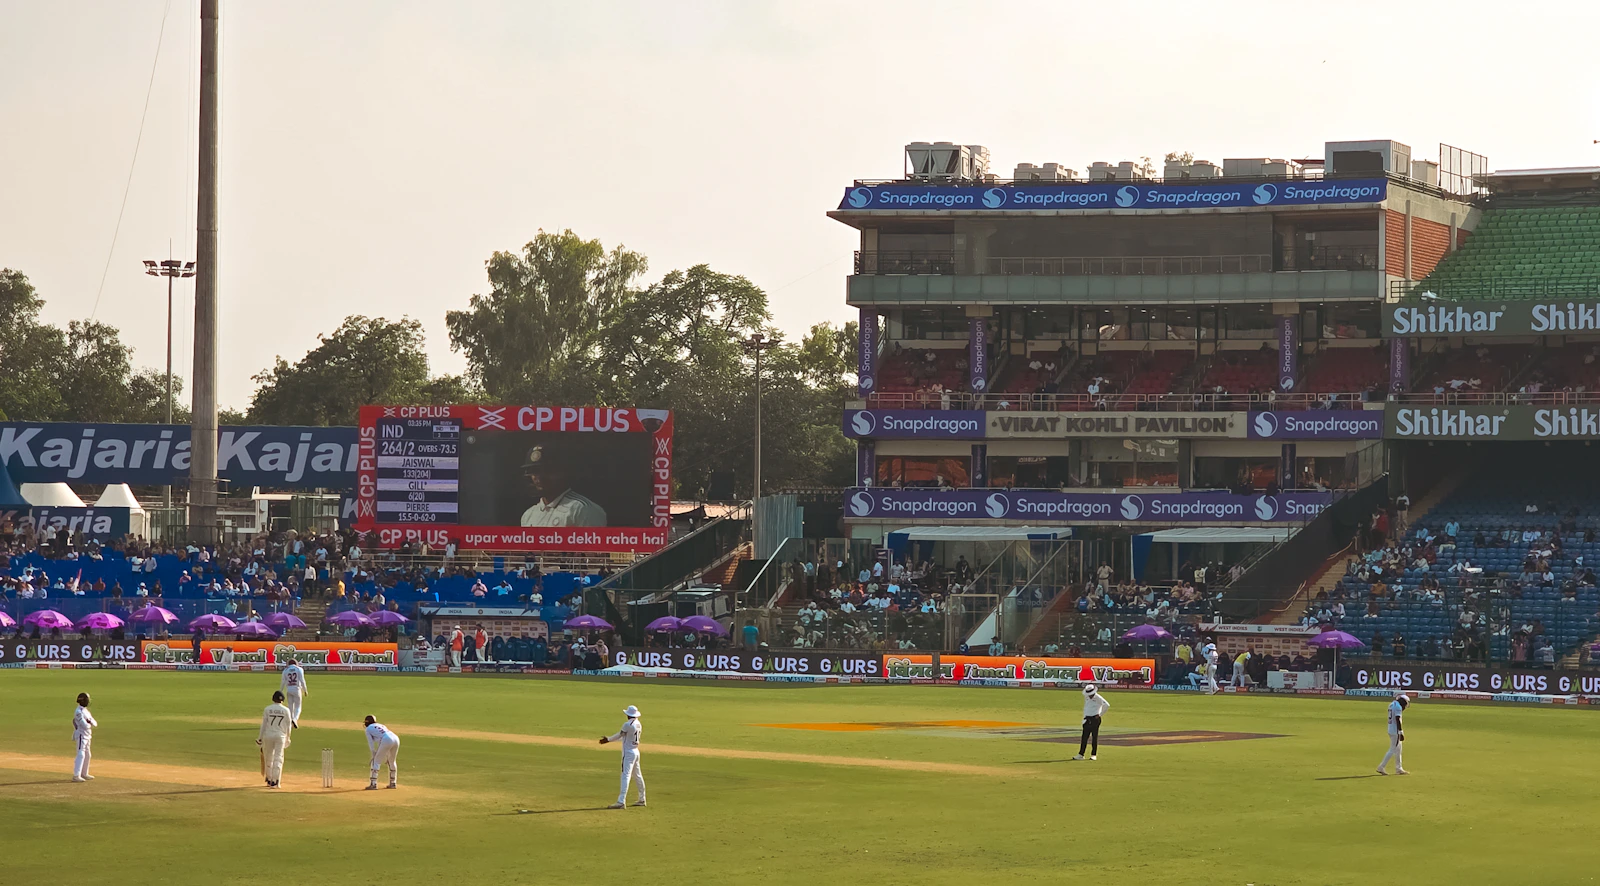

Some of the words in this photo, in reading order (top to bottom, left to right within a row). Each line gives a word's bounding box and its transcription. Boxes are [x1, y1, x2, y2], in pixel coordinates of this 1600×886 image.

[879, 191, 974, 206] Snapdragon
[1013, 190, 1108, 206] Snapdragon
[1145, 188, 1241, 206] Snapdragon
[1283, 184, 1380, 203] Snapdragon
[1392, 305, 1503, 334] Shikhar
[1530, 302, 1600, 334] Shik
[861, 316, 873, 372] Snapdragon
[974, 320, 985, 374] Snapdragon
[1282, 318, 1293, 373] Snapdragon
[400, 406, 417, 418] CP
[419, 406, 450, 418] PLUS
[517, 408, 554, 433] CP
[559, 408, 630, 433] PLUS
[407, 419, 422, 428] 03:35
[422, 419, 432, 428] PM
[882, 415, 978, 434] Snapdragon
[999, 416, 1060, 433] VIRAT
[1066, 416, 1128, 433] KOHLI
[1135, 416, 1227, 433] PAVILION
[1285, 416, 1378, 434] Snapdragon
[1396, 407, 1506, 437] Shikhar
[382, 424, 404, 439] IND
[0, 427, 191, 479] Kajaria
[360, 426, 376, 471] PLUS
[381, 441, 415, 456] 264/2
[418, 444, 437, 453] OVERS
[401, 458, 436, 468] JAISWAL
[656, 457, 670, 479] CP
[402, 469, 431, 480] 133(204)
[360, 474, 375, 498] CP
[408, 492, 425, 502] 6(20)
[653, 483, 669, 528] PLUS
[405, 503, 430, 512] PIERRE
[881, 496, 977, 516] Snapdragon
[1017, 498, 1111, 517] Snapdragon
[1150, 499, 1243, 518] Snapdragon
[379, 529, 402, 545] CP
[405, 529, 449, 545] PLUS
[465, 534, 499, 547] upar
[501, 533, 535, 545] wala
[538, 532, 565, 546] sab
[567, 532, 603, 546] dekh
[605, 532, 639, 546] raha
[642, 532, 665, 546] hai
[16, 643, 71, 660] GAURS
[210, 648, 267, 665] Vmal
[337, 650, 394, 665] Vimal
[615, 650, 672, 667] GAURS
[683, 653, 741, 671] GAURS
[751, 656, 809, 672] GAURS
[820, 659, 878, 674] GAURS
[1023, 660, 1082, 680] विमल
[287, 673, 298, 683] 32
[1091, 666, 1151, 683] Viml
[1357, 669, 1412, 687] GAURS
[1423, 671, 1480, 689] GAURS
[1491, 673, 1548, 691] GAURS
[269, 715, 285, 726] 77
